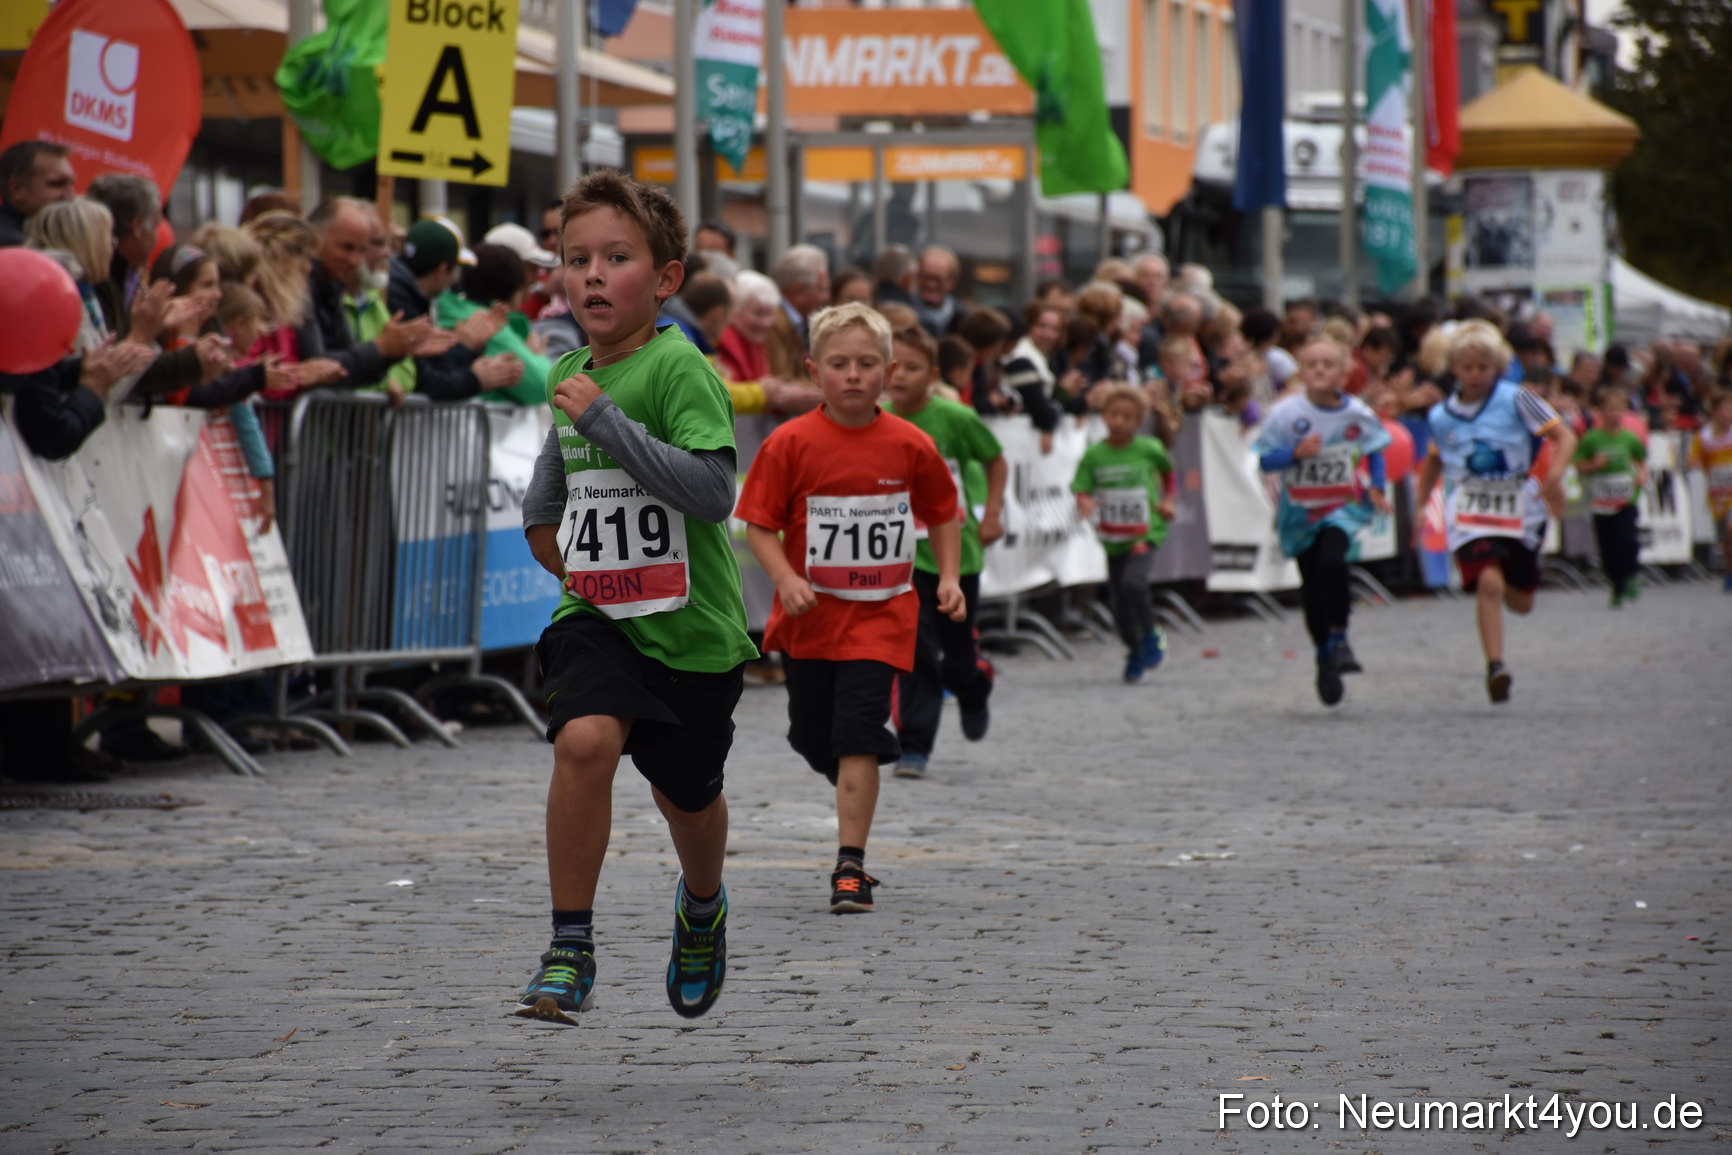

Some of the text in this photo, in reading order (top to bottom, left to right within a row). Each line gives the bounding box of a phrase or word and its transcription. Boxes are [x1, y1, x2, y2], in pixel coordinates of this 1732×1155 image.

[405, 0, 507, 32] Block
[783, 35, 1017, 87] NMARKT.DE
[408, 45, 483, 139] A
[71, 90, 128, 131] DKMS
[584, 484, 652, 500] Neumark
[1467, 492, 1516, 513] 7011
[810, 508, 846, 517] PARTL
[563, 504, 670, 563] 7419
[849, 571, 882, 586] Paul
